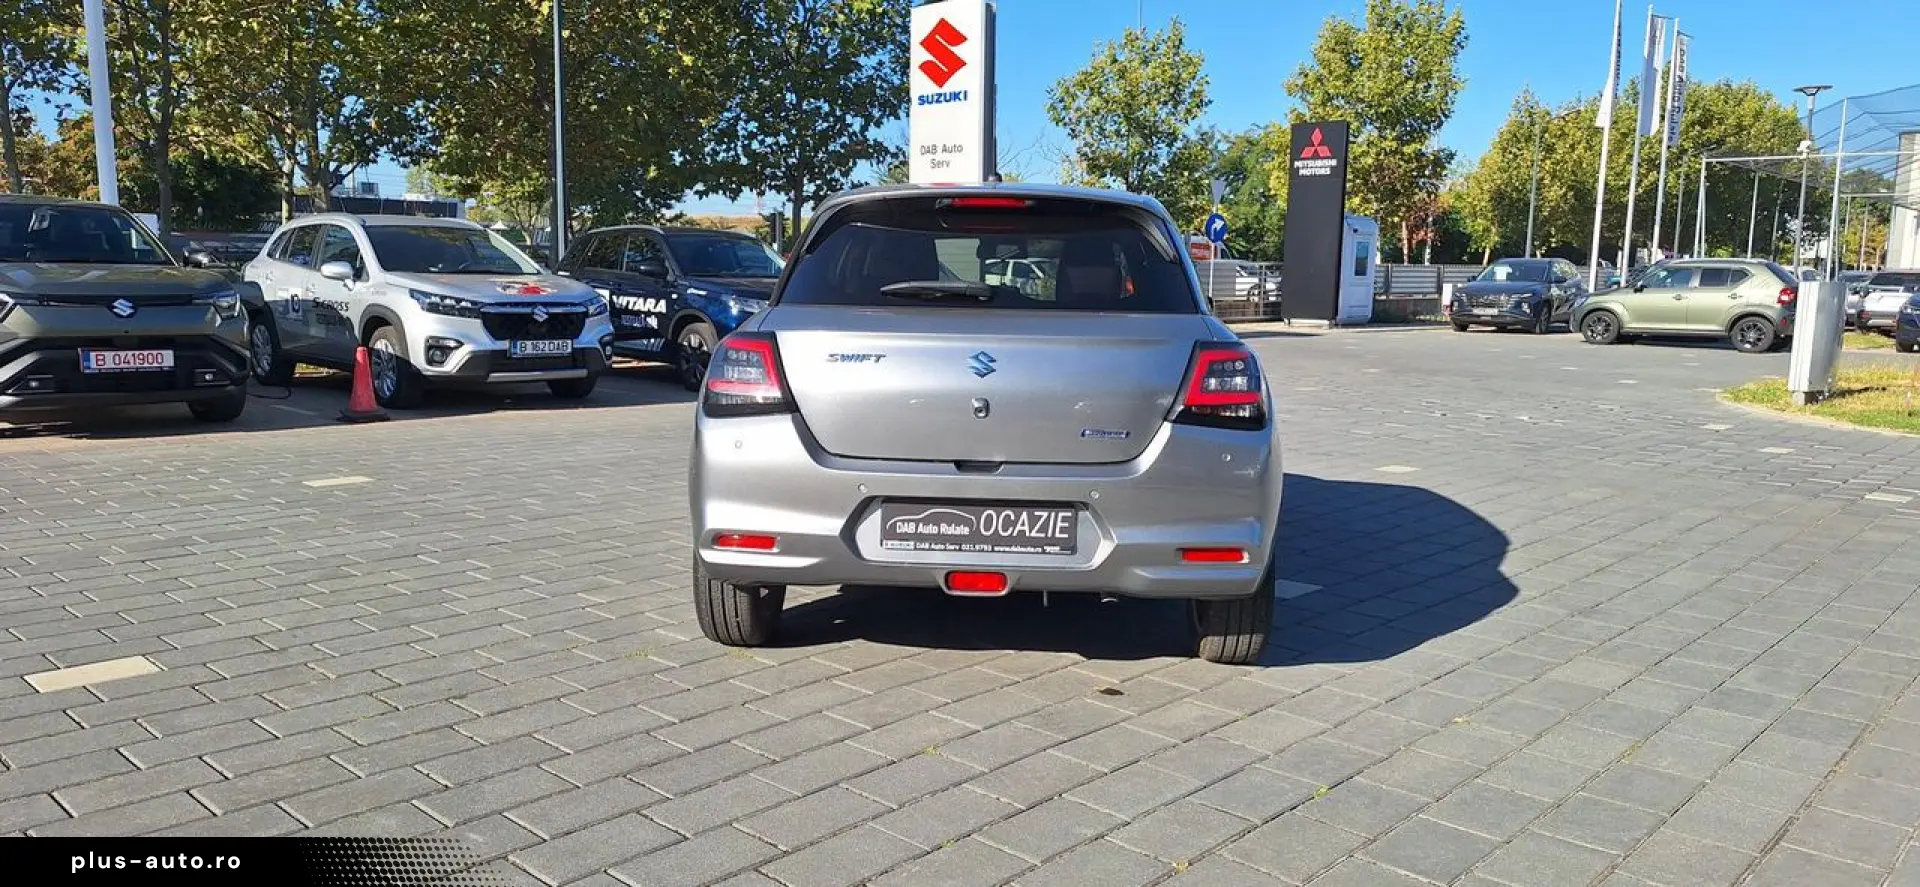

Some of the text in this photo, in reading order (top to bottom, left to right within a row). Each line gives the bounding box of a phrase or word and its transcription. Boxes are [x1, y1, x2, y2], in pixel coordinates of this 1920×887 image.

[917, 90, 968, 106] SUZUKI
[920, 143, 964, 156] DAB Auto
[930, 158, 951, 169] Serv
[1294, 158, 1337, 168] MITSUBISHI
[1298, 167, 1331, 177] MOTORS
[611, 294, 667, 314] VITARA
[520, 342, 527, 352] B
[95, 352, 164, 367] B 041900
[825, 353, 887, 363] SWIFT
[896, 522, 970, 535] DAB Auto Rulate
[980, 509, 1073, 538] OCAZIE
